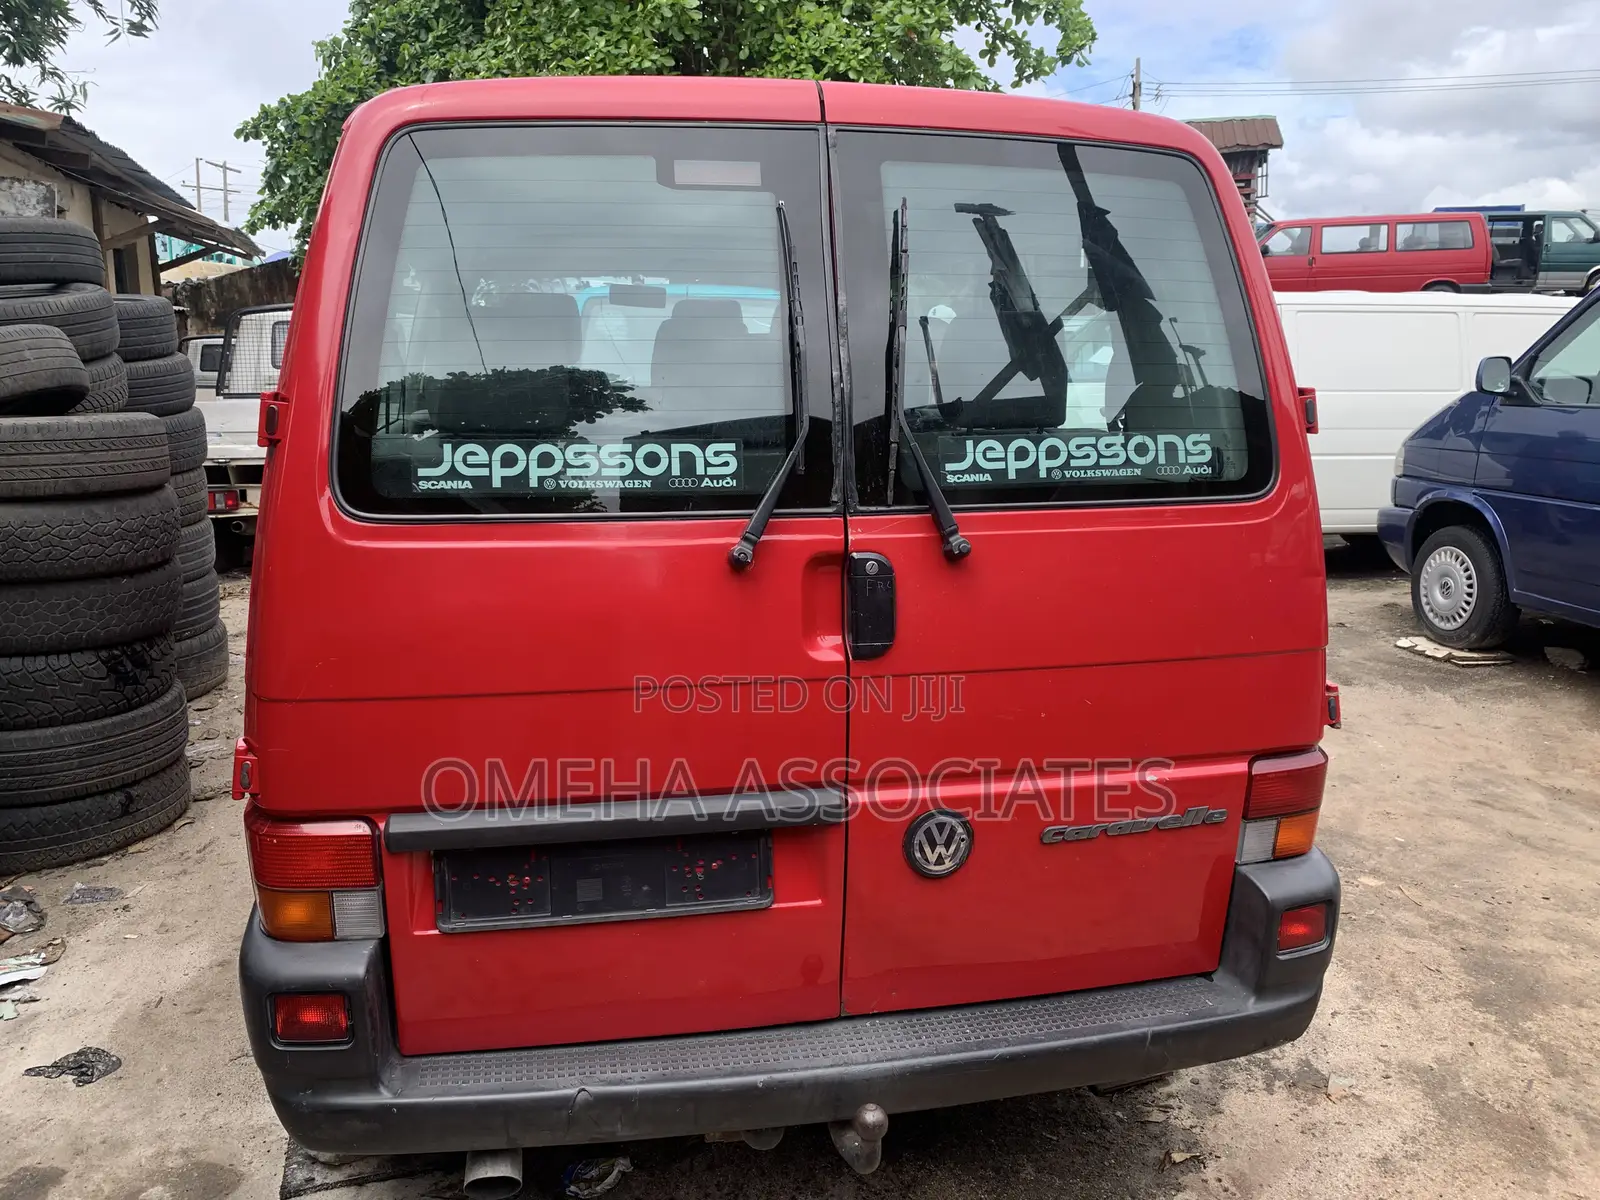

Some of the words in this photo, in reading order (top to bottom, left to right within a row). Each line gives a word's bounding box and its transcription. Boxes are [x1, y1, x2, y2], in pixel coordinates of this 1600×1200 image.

[945, 433, 1212, 480] Jeppssons
[417, 442, 738, 489] Jeppssons
[1182, 465, 1212, 475] Audi
[946, 473, 992, 483] SCANIA
[1064, 468, 1142, 478] VOLKSWAGEN
[418, 480, 473, 490] SCANIA
[559, 479, 652, 489] VOLKSWAGEN
[700, 477, 737, 487] Audi
[1040, 806, 1228, 845] caravelle
